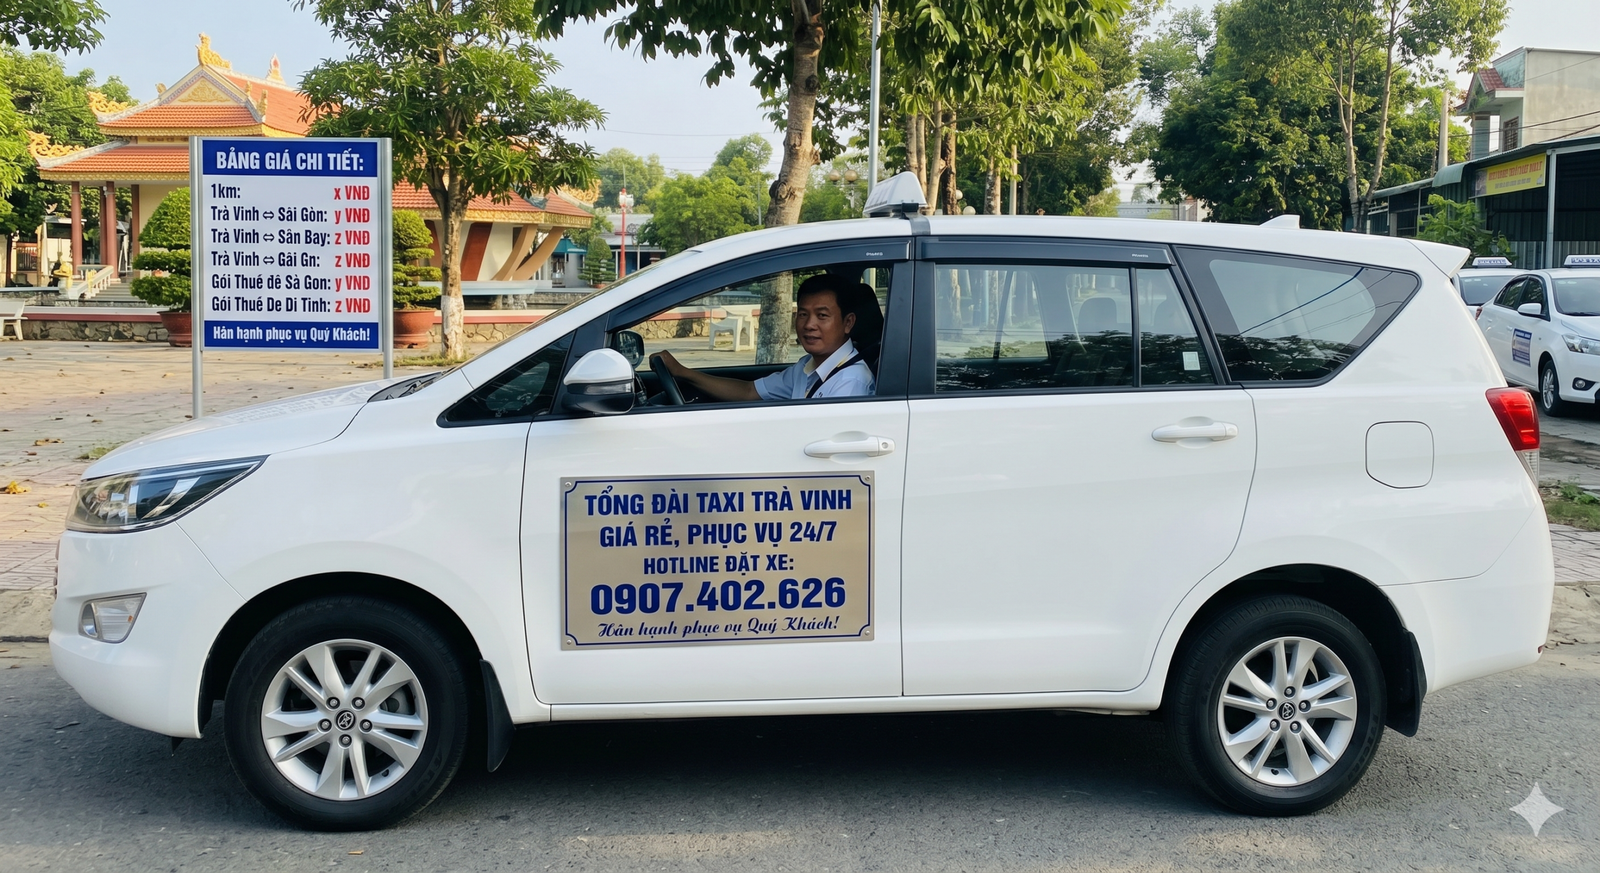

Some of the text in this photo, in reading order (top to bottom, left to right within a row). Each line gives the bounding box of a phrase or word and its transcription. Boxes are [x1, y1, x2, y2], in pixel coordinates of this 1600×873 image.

[216, 147, 363, 170] BẢNG GIÁ CHI TIẾT:
[211, 184, 370, 200] 1km: x VNĐ
[211, 206, 229, 220] Trà
[234, 206, 259, 221] Vinh
[301, 207, 327, 222] Gòn:
[335, 210, 341, 224] y
[345, 208, 370, 222] VNĐ
[211, 228, 370, 246] Trà Vinh Sân Bay: z VNĐ
[211, 251, 229, 266] Trà
[234, 252, 259, 266] Vinh
[301, 252, 319, 267] Gn:
[335, 255, 341, 267] z
[345, 253, 370, 267] VNĐ
[212, 274, 230, 288] Gói
[286, 274, 300, 289] Sà
[305, 275, 330, 290] Gon:
[335, 278, 341, 292] y
[212, 296, 230, 311] Gói
[267, 297, 281, 312] De
[286, 298, 297, 312] Di
[301, 298, 330, 312] Tinh:
[335, 301, 341, 312] z
[237, 327, 262, 342] hạnh
[266, 327, 291, 343] phục
[295, 330, 307, 343] vụ
[310, 327, 330, 342] Quý
[333, 328, 370, 341] Khách!
[585, 485, 852, 516] TỔNG ĐÀI TAXI TRÀ VINH
[600, 518, 837, 548] GIÁ RẺ, PHỤC VỤ 24/7
[644, 552, 794, 575] HOTLINE ĐẶT XE:
[591, 577, 845, 615] 0907.402.626
[598, 616, 839, 638] Hân hạnh phục vụ Quý Khách!
